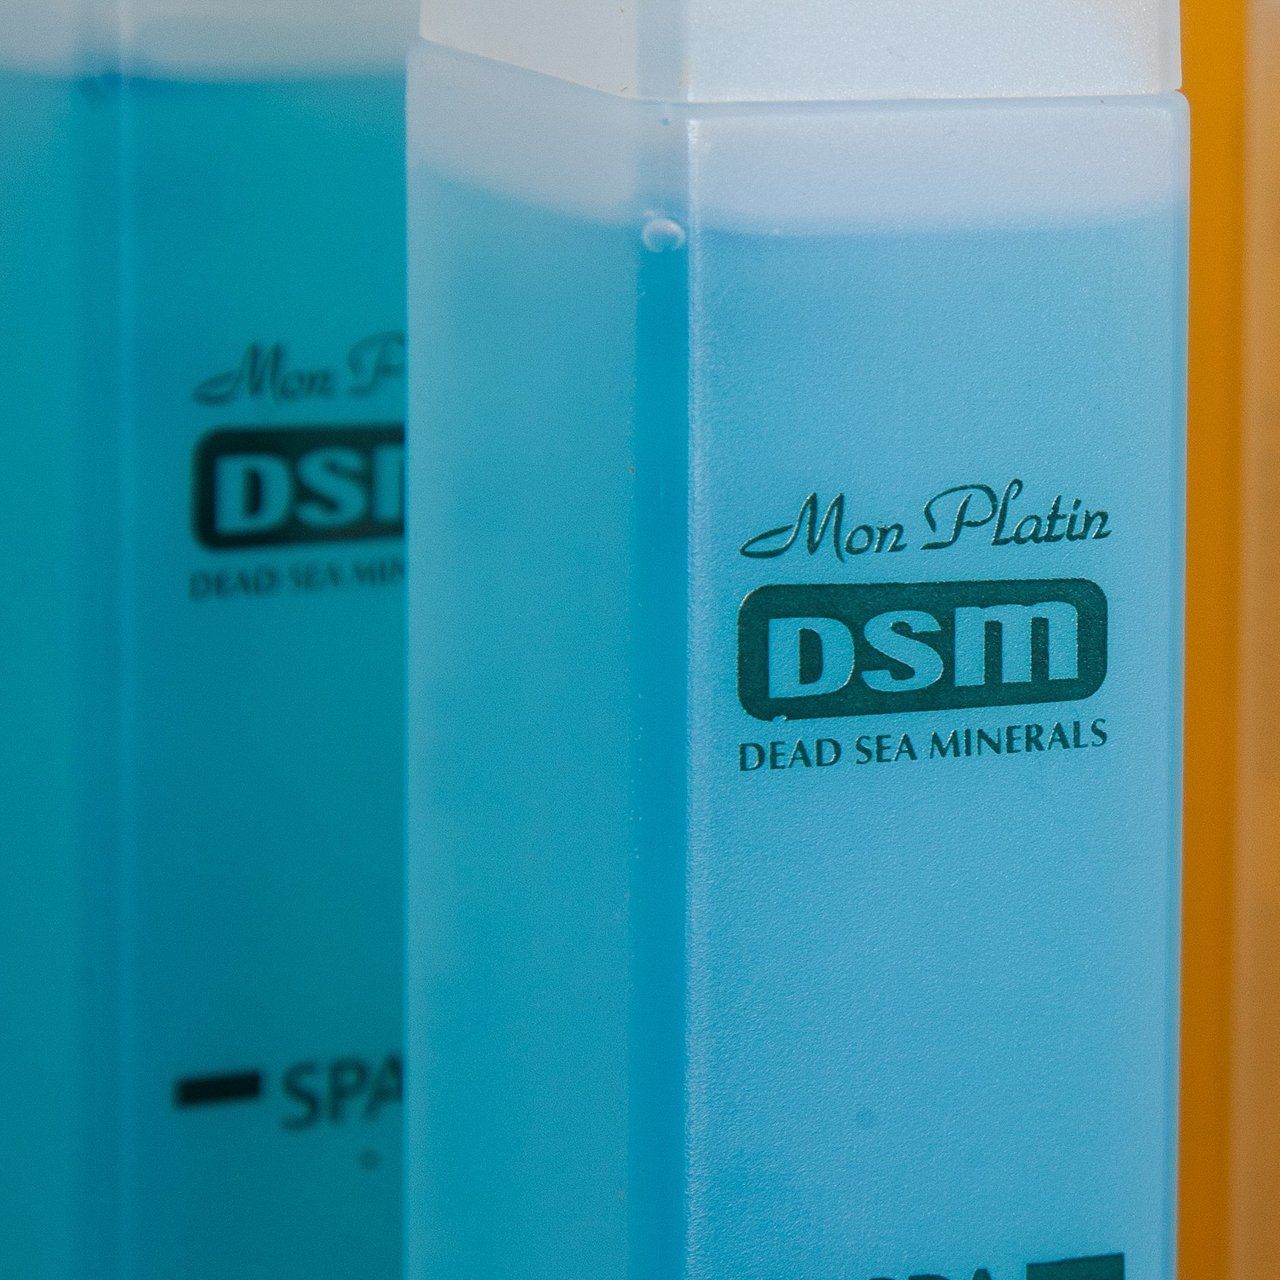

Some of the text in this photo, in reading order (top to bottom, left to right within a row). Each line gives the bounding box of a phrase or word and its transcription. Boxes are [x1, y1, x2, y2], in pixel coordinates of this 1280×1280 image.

[213, 443, 404, 536] DS
[740, 478, 1112, 562] Mon Platin
[739, 718, 1108, 772] DEAD SEA MINERALS
[280, 1053, 403, 1132] SPA
